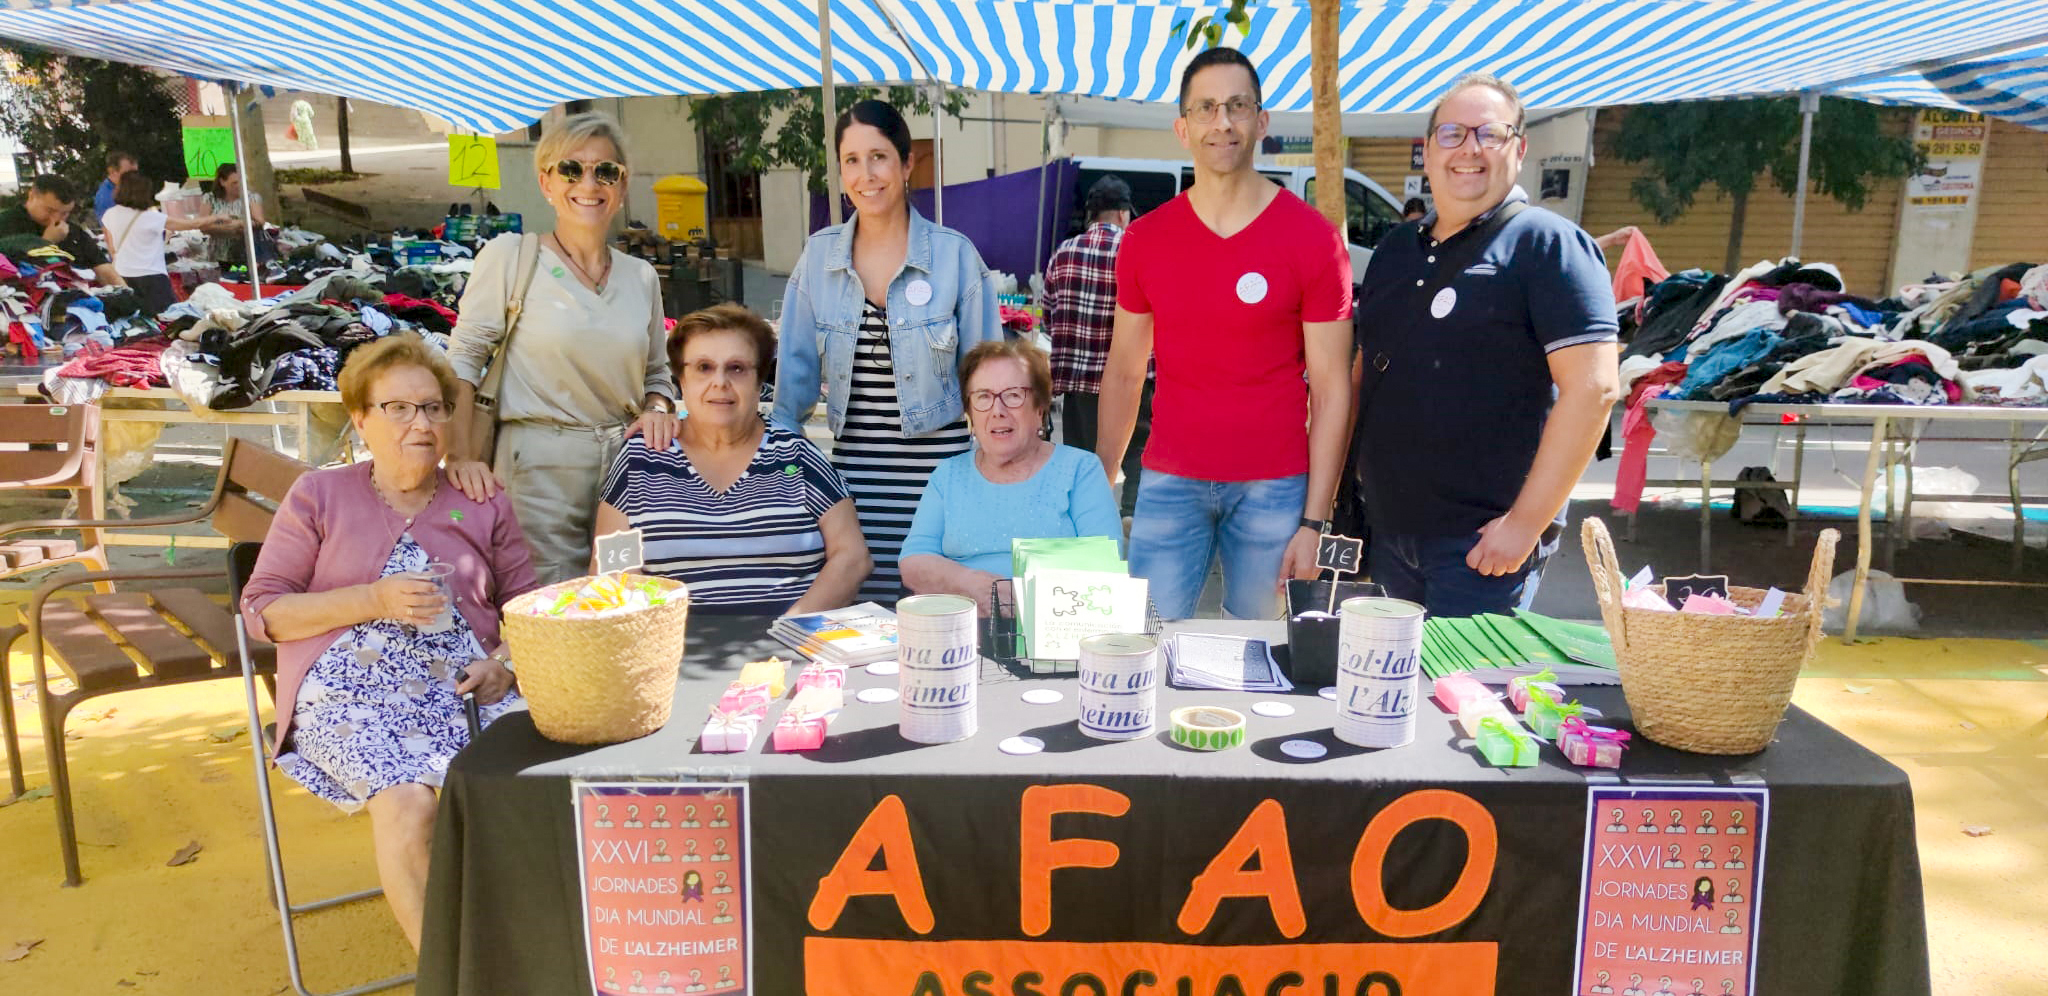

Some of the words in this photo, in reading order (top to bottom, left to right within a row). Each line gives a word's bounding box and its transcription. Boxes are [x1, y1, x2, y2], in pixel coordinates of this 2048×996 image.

[1953, 142, 1966, 155] 50
[1968, 142, 1980, 155] 50
[189, 147, 218, 177] 10
[453, 142, 489, 180] 12
[591, 839, 648, 865] XXVI
[807, 784, 1498, 939] AFAO
[1598, 844, 1661, 870] XXVI
[591, 876, 678, 895] JORNADES
[1594, 880, 1688, 900] JORNADES
[595, 906, 621, 924] DIA
[627, 909, 707, 926] MUNDIAL
[1594, 910, 1624, 929] DIA
[1632, 913, 1715, 933] MUNDIAL
[599, 936, 619, 955] DE
[624, 938, 738, 957] L'ALZHEIMER
[1594, 941, 1619, 959] DE
[1625, 945, 1743, 965] L'ALZHEIMER
